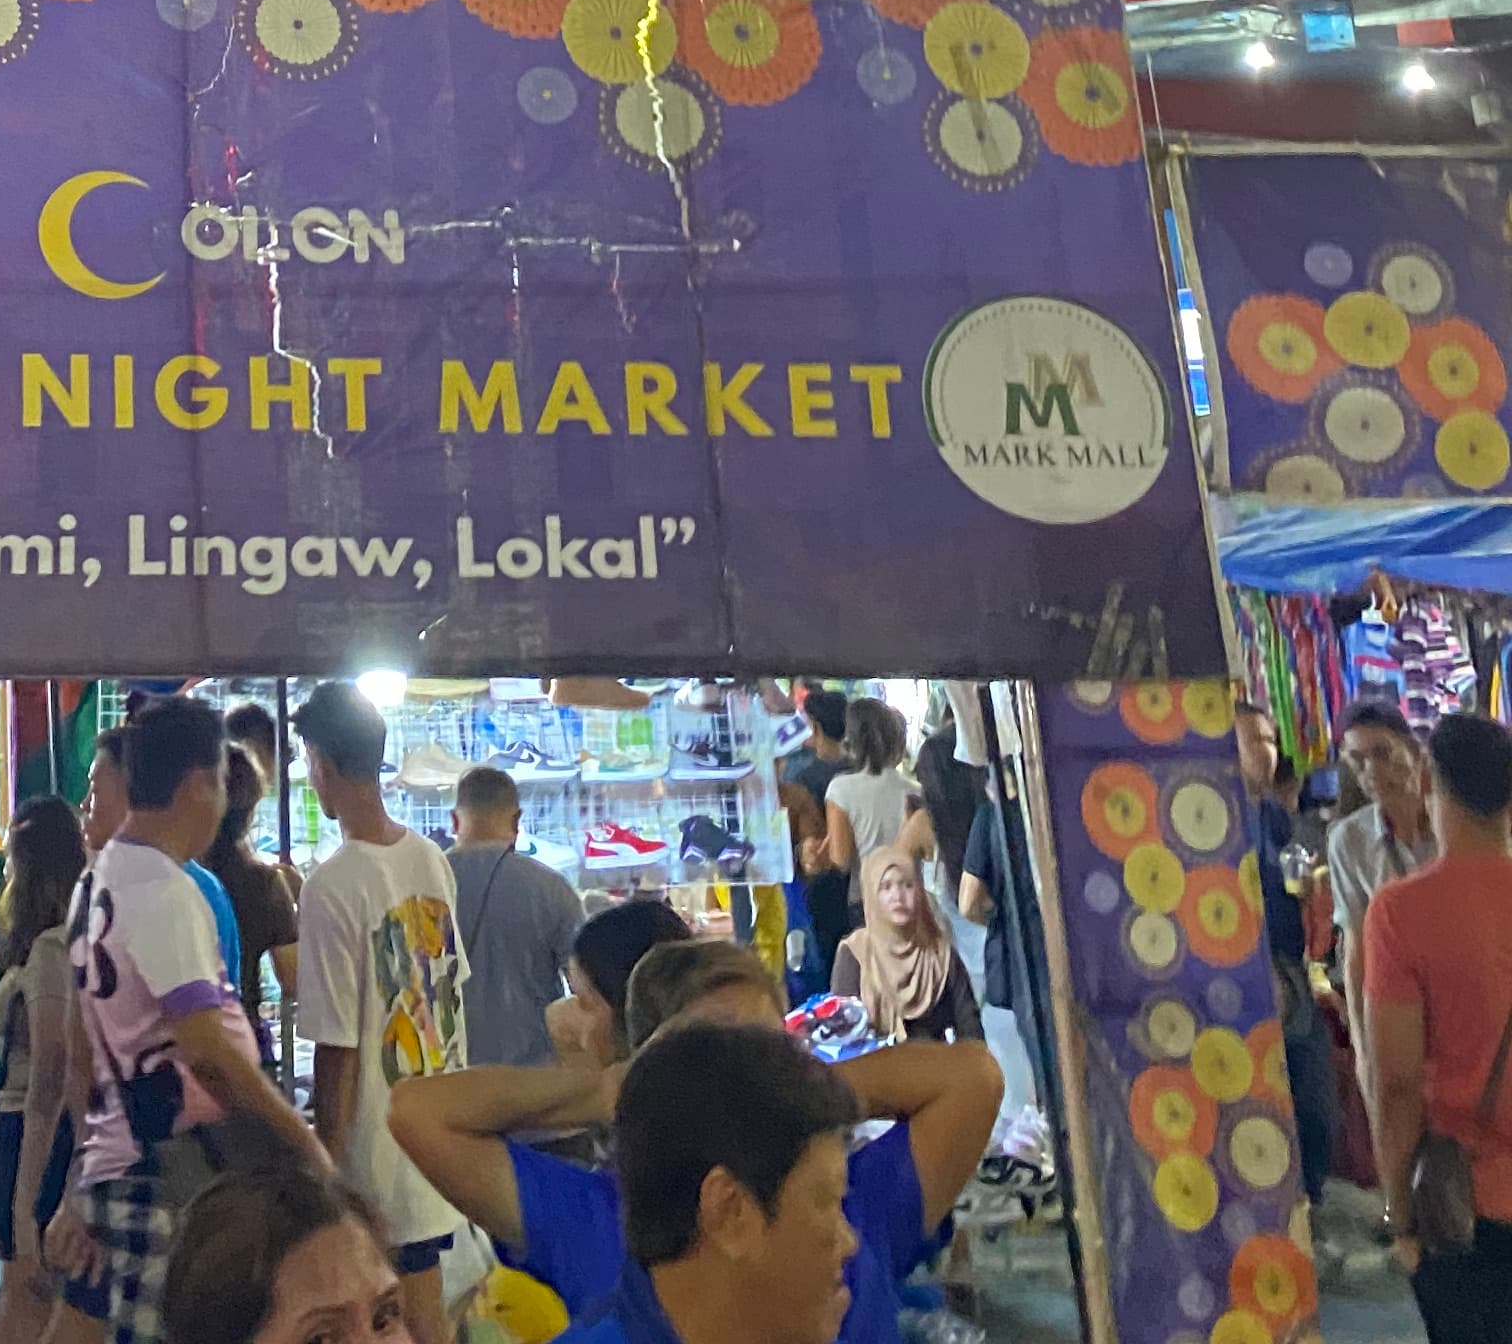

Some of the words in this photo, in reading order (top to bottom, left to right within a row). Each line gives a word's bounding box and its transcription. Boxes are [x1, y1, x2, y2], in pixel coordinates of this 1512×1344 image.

[20, 349, 382, 435] NIGHT
[436, 358, 903, 439] MARKET
[963, 443, 1057, 467] MARK
[1066, 443, 1156, 469] MALL
[126, 515, 434, 596] Lingaw,
